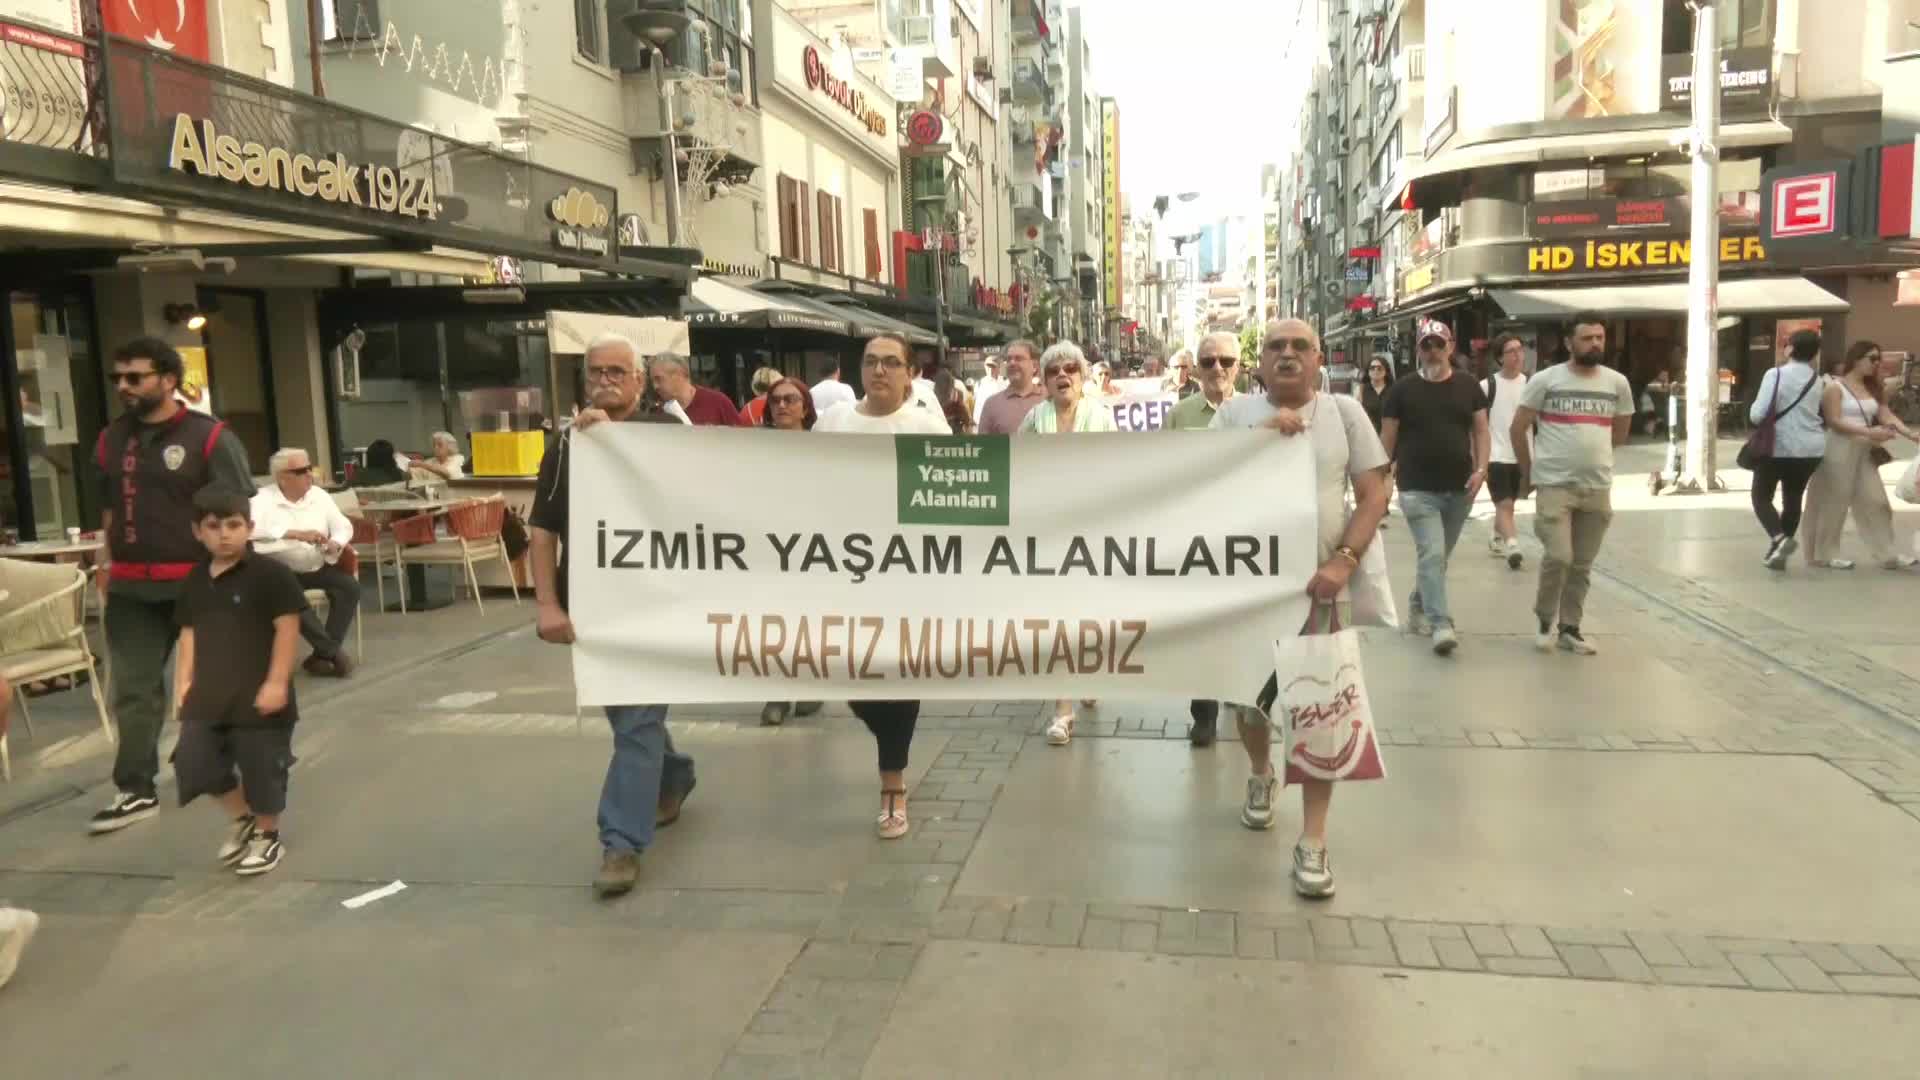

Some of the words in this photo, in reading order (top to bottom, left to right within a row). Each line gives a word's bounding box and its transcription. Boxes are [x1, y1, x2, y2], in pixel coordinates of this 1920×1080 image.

[169, 112, 362, 205] Alsancak
[1528, 246, 1575, 271] HD
[1585, 235, 1765, 269] İSKENER
[924, 440, 984, 458] İzmir
[918, 464, 990, 487] Yaşam
[910, 489, 997, 508] Alanları
[596, 520, 749, 571] İZMİR
[766, 532, 962, 584] YAŞAM
[981, 535, 1280, 577] ALANLARI
[707, 613, 885, 680] TARAFIZ
[899, 616, 1147, 679] MUHATABIZ
